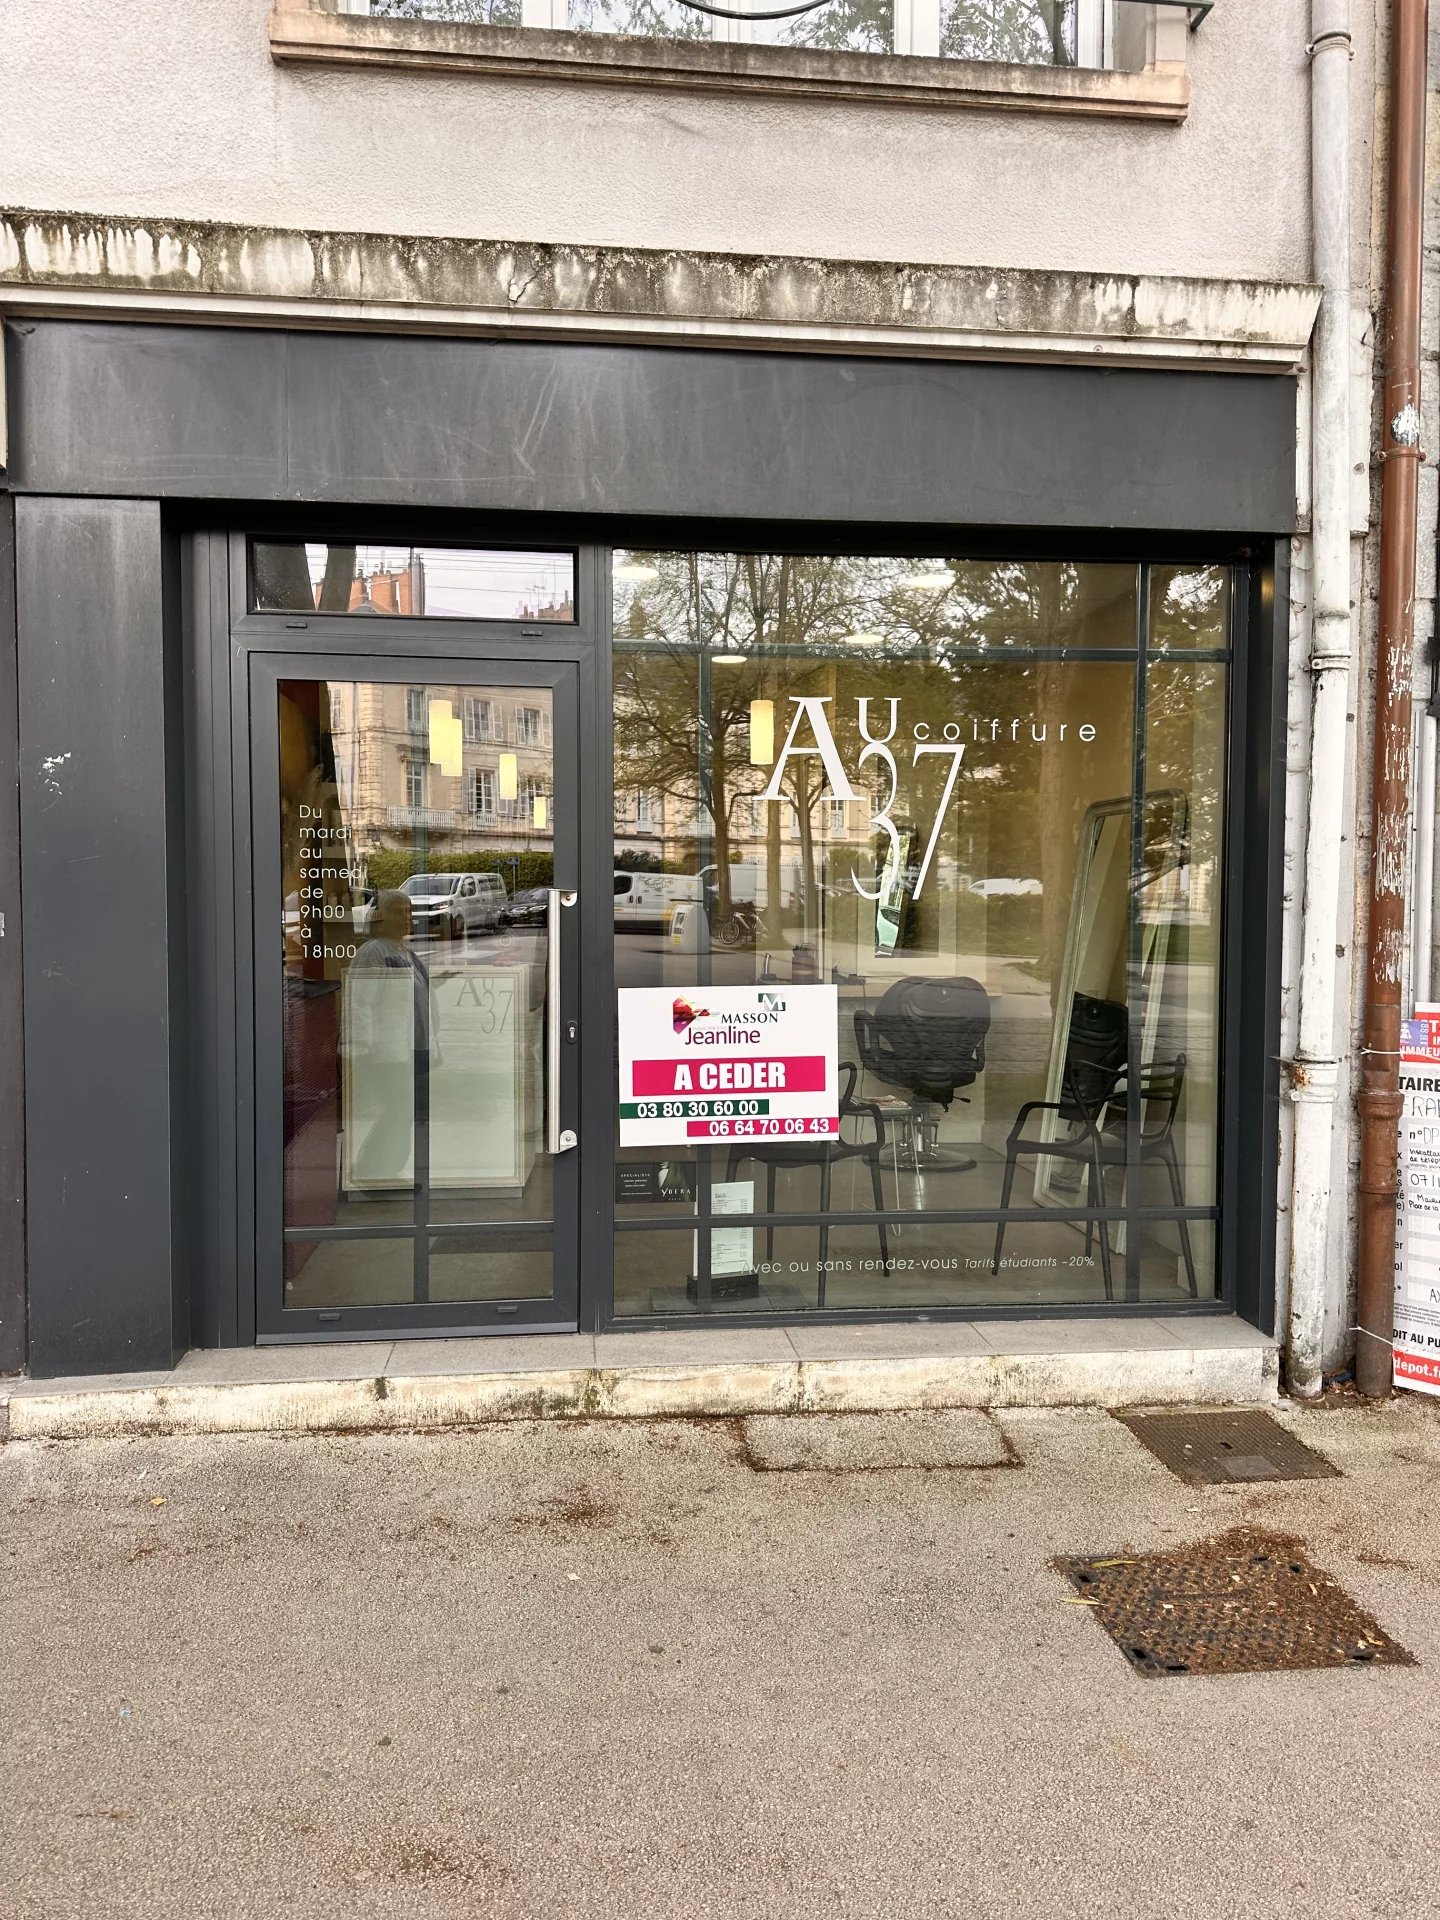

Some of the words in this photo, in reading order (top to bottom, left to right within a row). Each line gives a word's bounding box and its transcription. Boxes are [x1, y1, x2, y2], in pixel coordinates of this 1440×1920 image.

[752, 696, 902, 801] AU
[914, 718, 1097, 742] coiffure
[299, 805, 322, 819] Du
[851, 741, 965, 901] 37
[299, 826, 352, 839] mardi
[300, 847, 322, 859] au
[300, 865, 367, 879] samedi
[300, 886, 324, 899] de
[300, 905, 345, 919] 9h00
[300, 926, 312, 939] à
[303, 944, 357, 959] 18h00
[721, 1012, 779, 1024] MASSON
[685, 1026, 761, 1046] Jeanline
[673, 1064, 694, 1091] A
[699, 1062, 786, 1090] CEDER
[637, 1103, 658, 1118] 03
[662, 1102, 683, 1117] 80
[688, 1101, 709, 1116] 30
[713, 1100, 734, 1115] 60
[738, 1100, 759, 1115] 00
[709, 1121, 730, 1136] 06
[734, 1120, 755, 1135] 64
[759, 1120, 780, 1134] 70
[784, 1119, 805, 1133] 06
[809, 1118, 830, 1133] 43
[741, 1261, 782, 1274] Avec
[789, 1261, 809, 1273] ou
[816, 1260, 852, 1272] sans
[859, 1256, 958, 1271] rendez-vous
[964, 1258, 996, 1269] Tarifs
[1000, 1256, 1058, 1268] étudiants
[1061, 1256, 1095, 1267] -20%
[1410, 1333, 1424, 1344] AU
